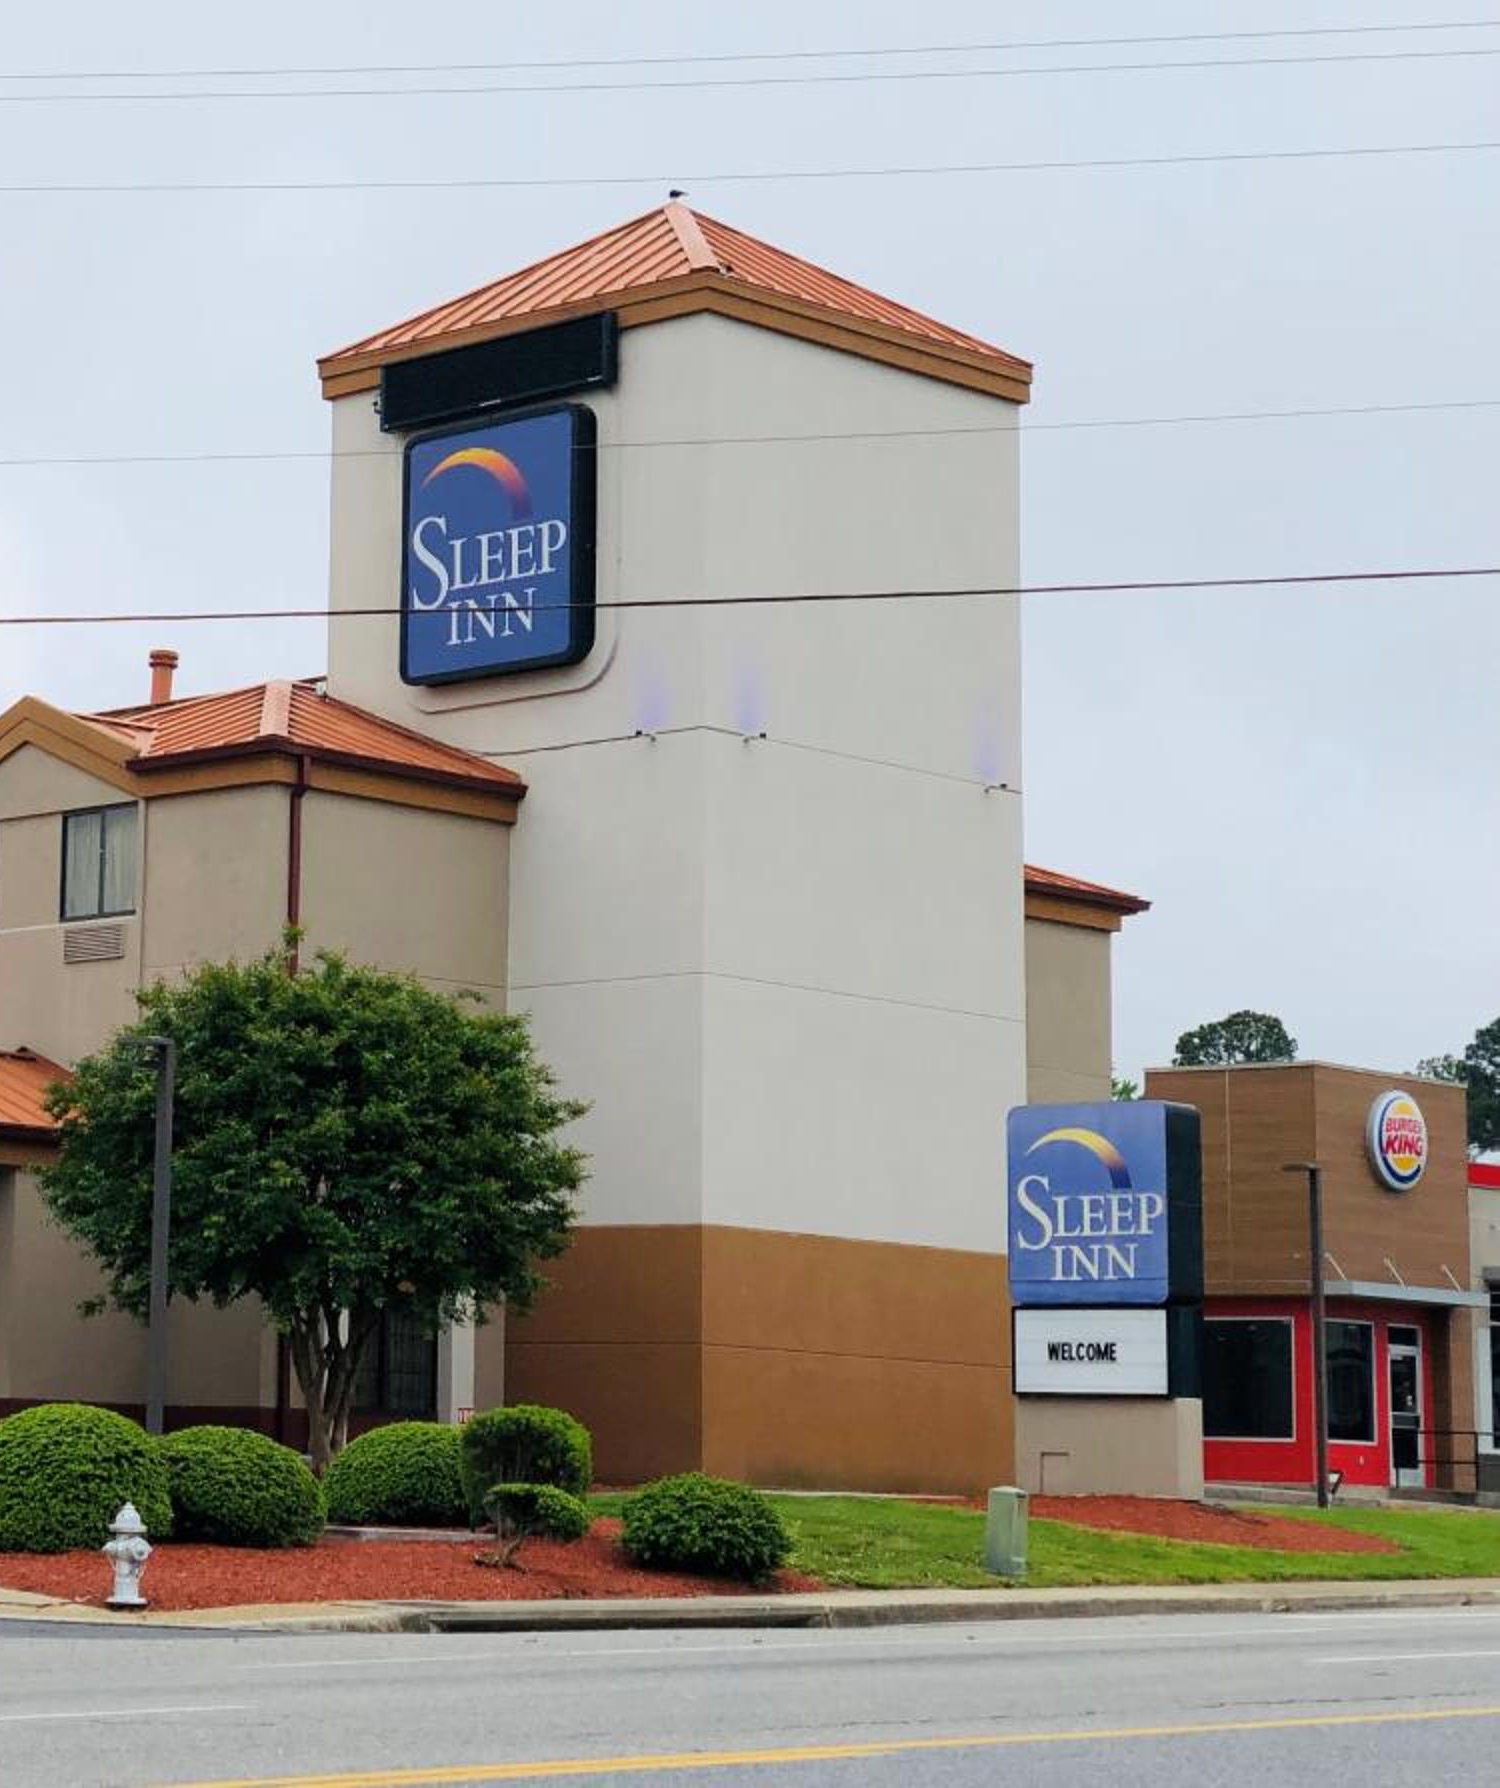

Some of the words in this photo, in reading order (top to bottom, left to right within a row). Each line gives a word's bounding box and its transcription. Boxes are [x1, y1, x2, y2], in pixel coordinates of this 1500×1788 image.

[413, 516, 567, 610] SLEEP
[446, 588, 538, 645] INN
[1385, 1134, 1422, 1156] KING
[1017, 1175, 1163, 1250] SLEEP
[1051, 1244, 1138, 1281] INN
[1047, 1343, 1117, 1361] WELCOME
